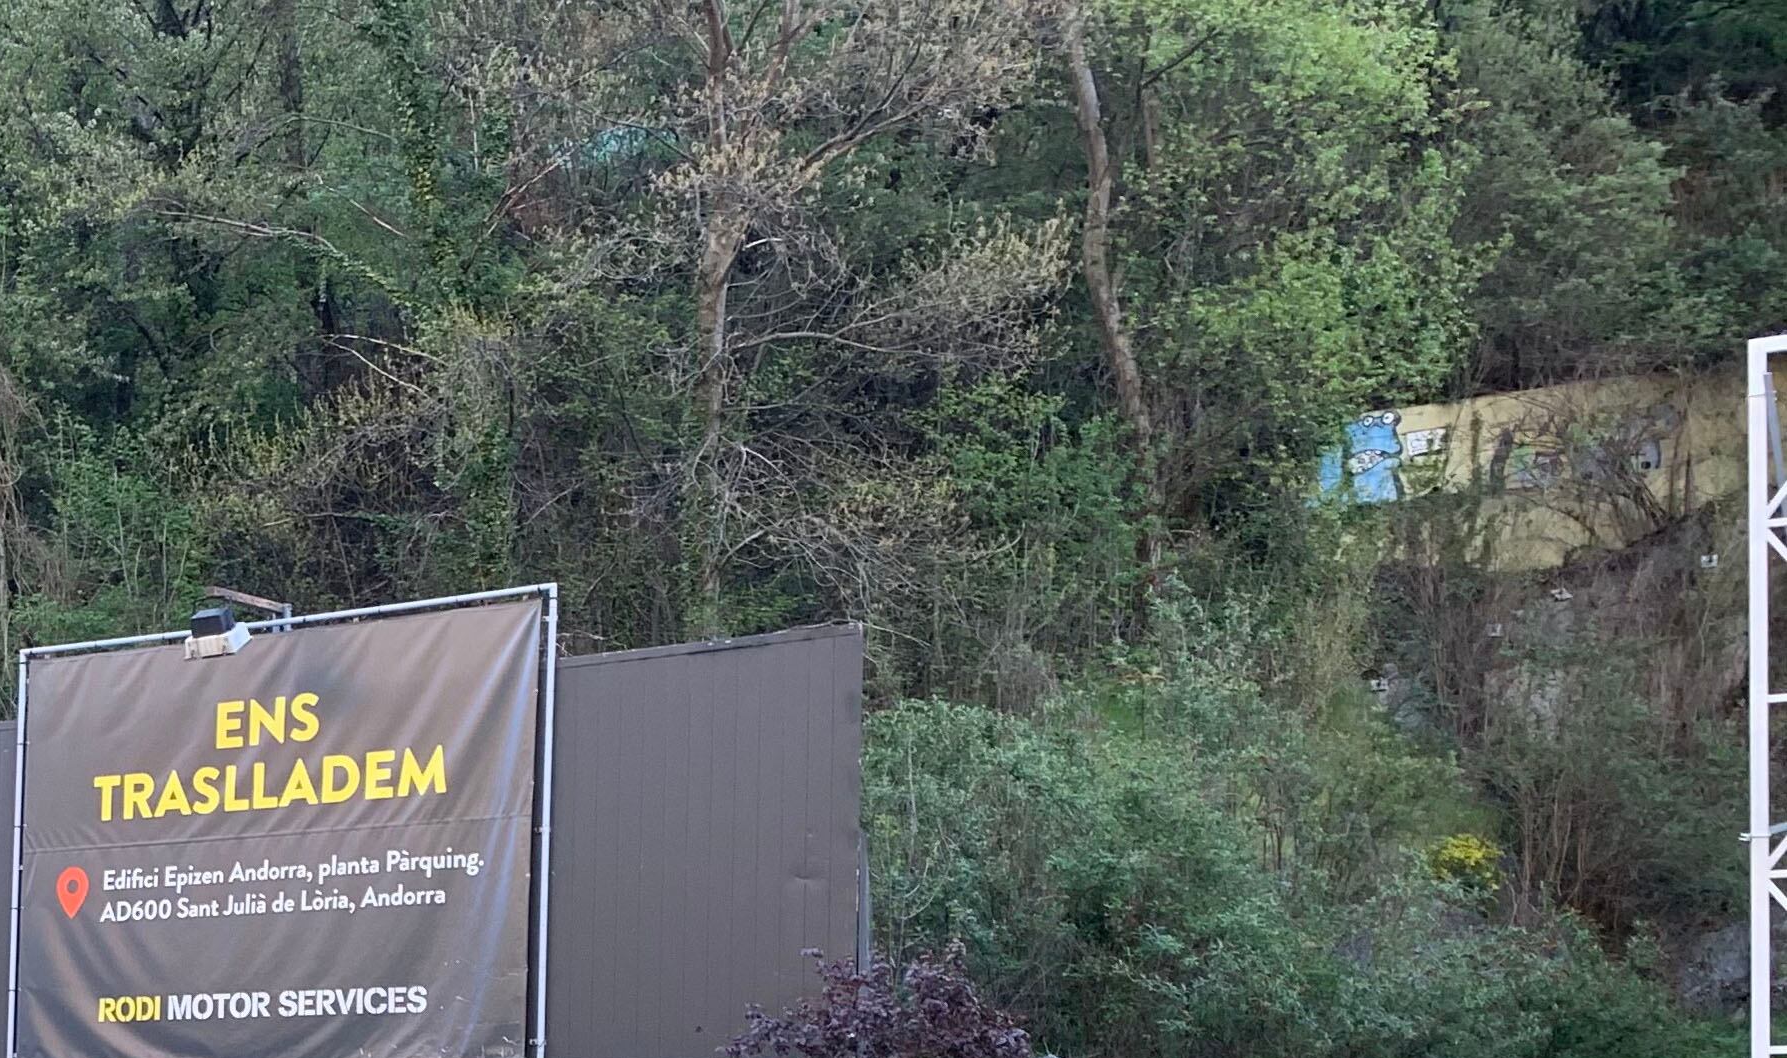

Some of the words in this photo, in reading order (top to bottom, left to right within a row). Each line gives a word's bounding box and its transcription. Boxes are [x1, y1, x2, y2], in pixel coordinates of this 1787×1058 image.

[215, 692, 320, 750] ENS
[93, 744, 448, 822] TRASLLADEM
[102, 868, 159, 891] Edifici
[163, 865, 224, 894] Epizen
[227, 858, 314, 883] Andorra,
[317, 854, 380, 885] planta
[386, 847, 485, 878] Pàrquing.
[99, 899, 172, 923] AD600
[176, 897, 219, 919] Sant
[222, 892, 267, 916] Julià
[271, 891, 295, 913] de
[300, 888, 356, 914] Lòria,
[360, 884, 446, 908] Andorra
[97, 996, 162, 1023] RODI
[166, 992, 271, 1022] MOTOR
[277, 985, 428, 1017] SERVICES
